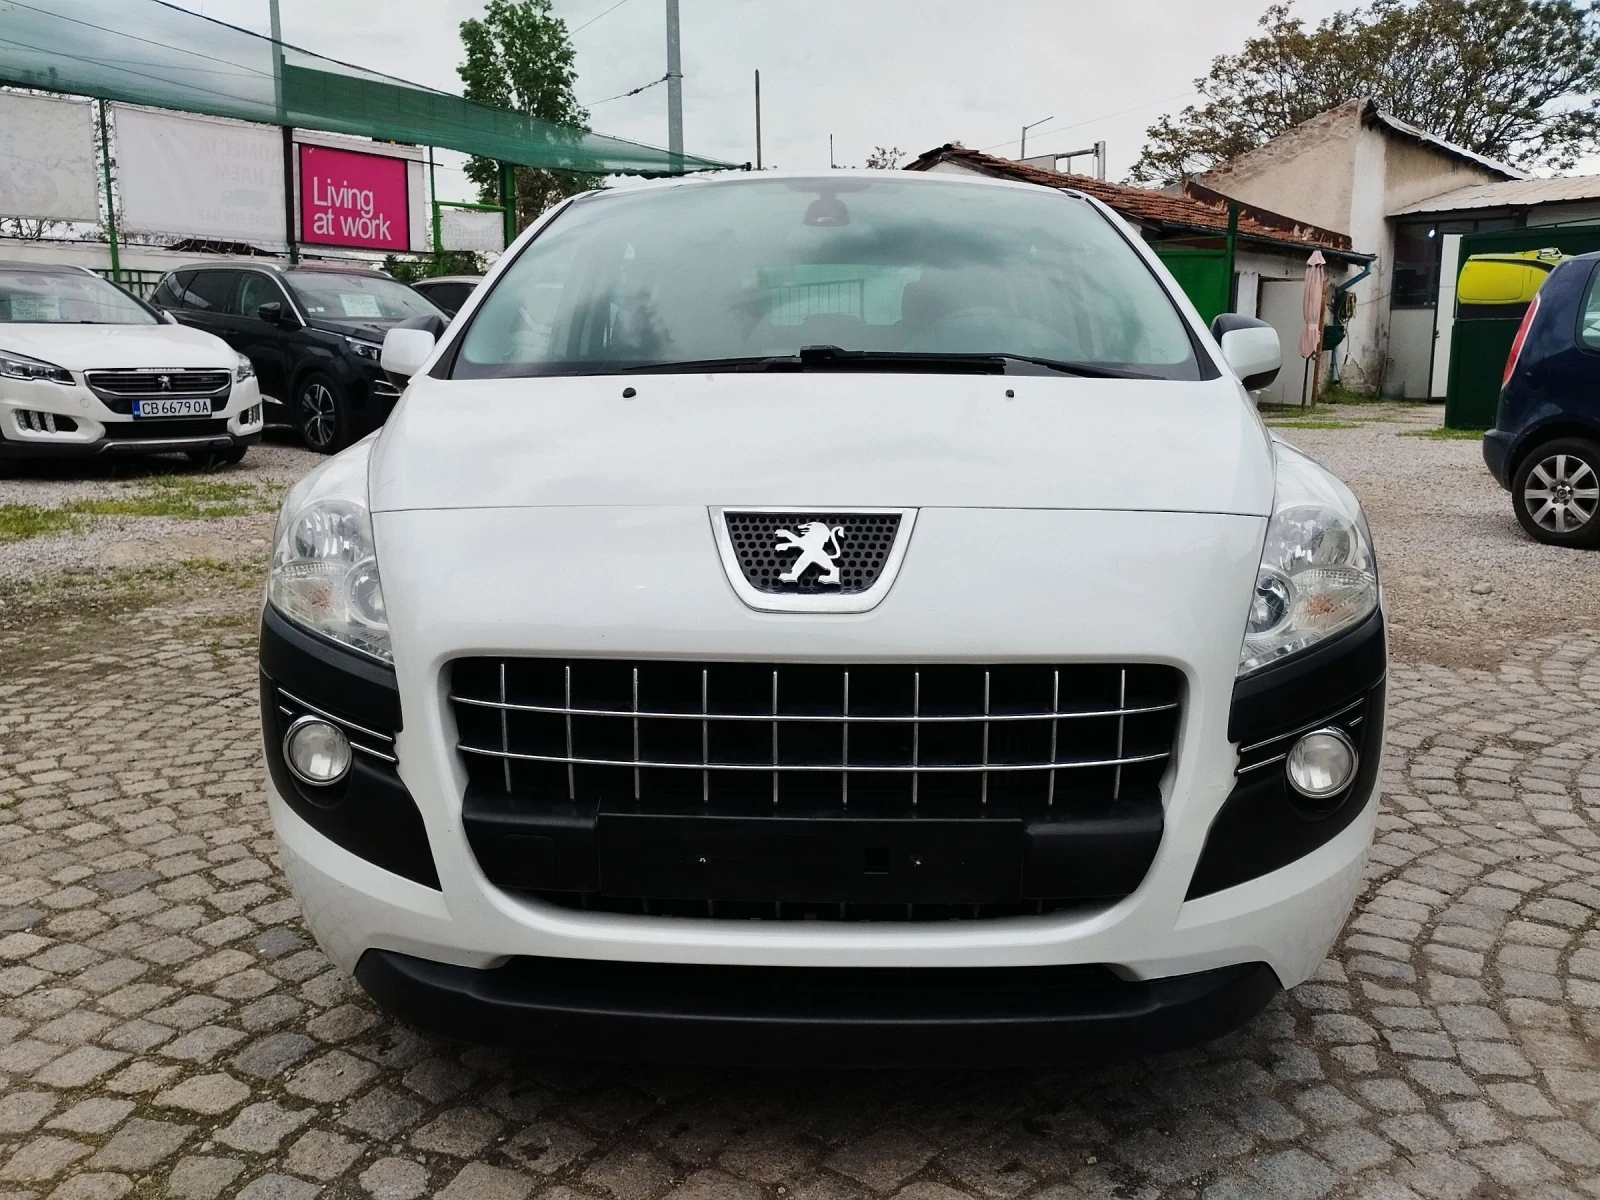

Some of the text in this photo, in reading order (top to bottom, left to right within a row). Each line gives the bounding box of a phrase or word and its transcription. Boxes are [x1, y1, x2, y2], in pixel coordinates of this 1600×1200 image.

[313, 176, 374, 219] Living
[313, 208, 392, 241] at work
[142, 402, 160, 415] CB
[161, 401, 191, 414] 6679
